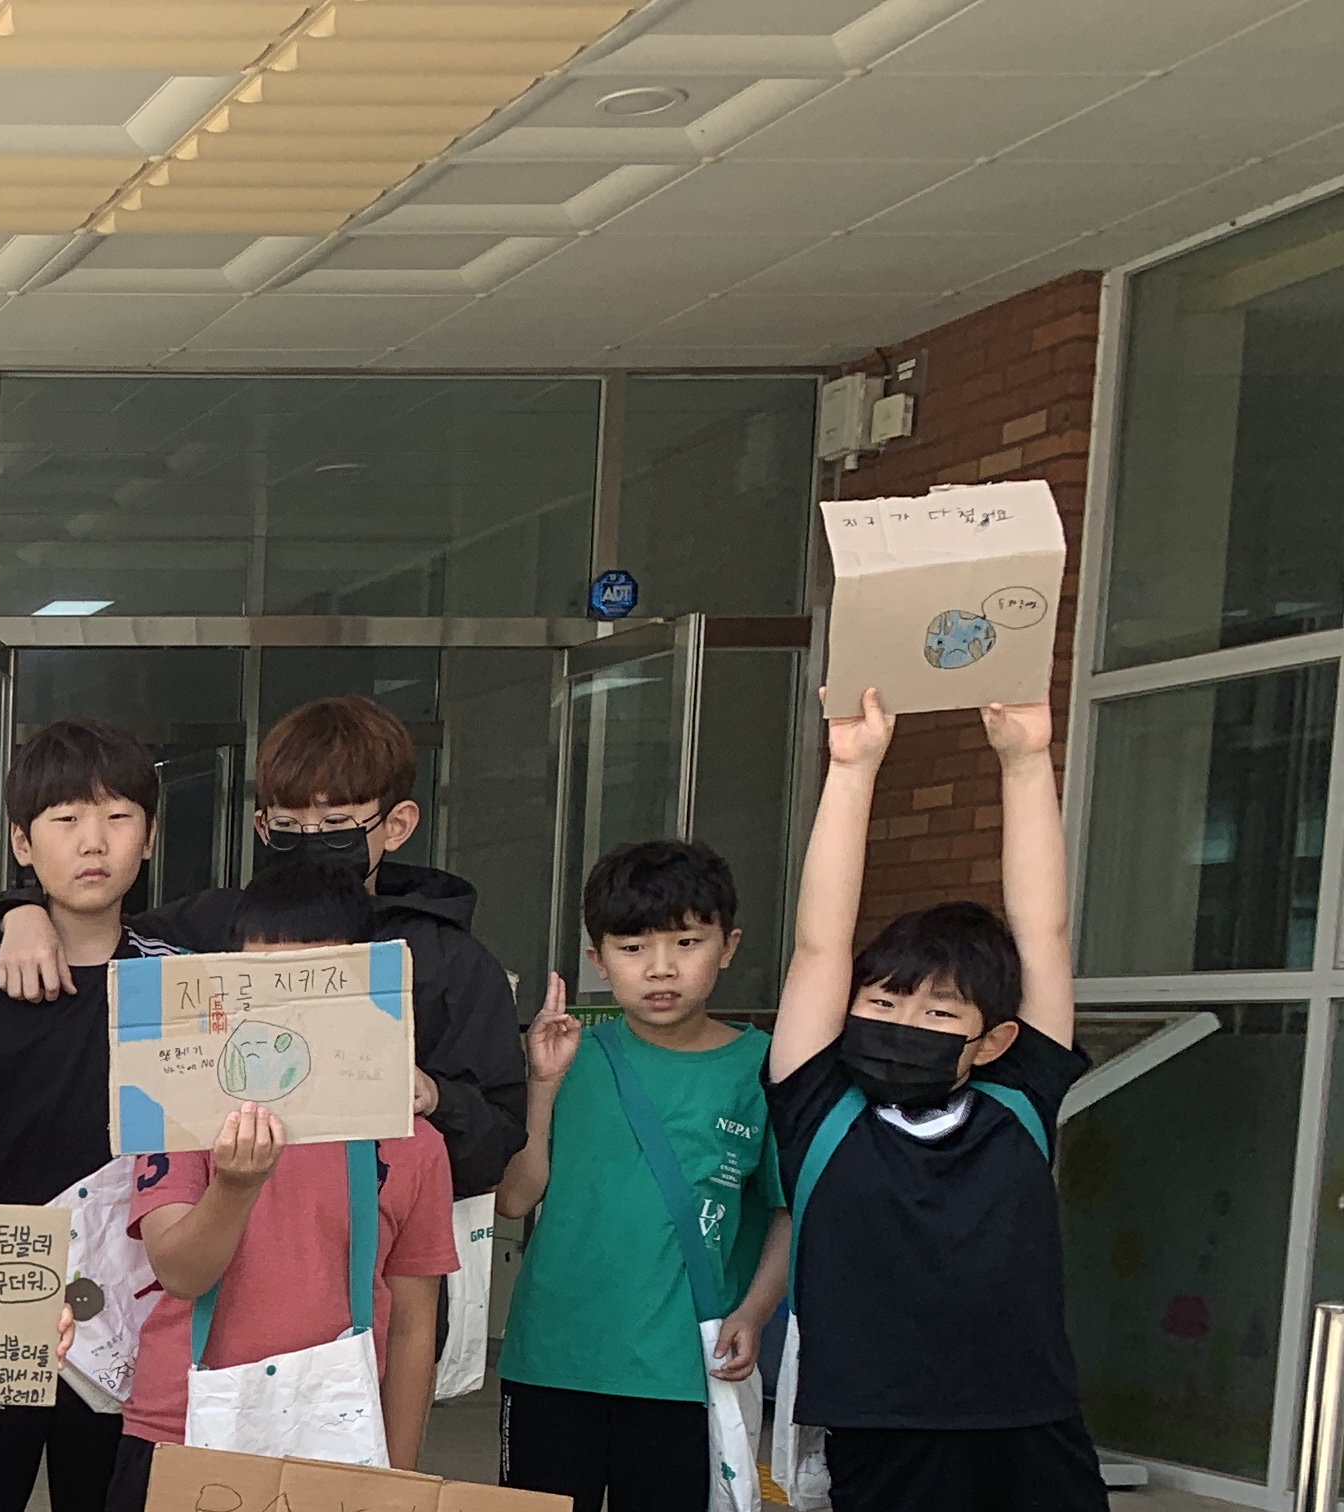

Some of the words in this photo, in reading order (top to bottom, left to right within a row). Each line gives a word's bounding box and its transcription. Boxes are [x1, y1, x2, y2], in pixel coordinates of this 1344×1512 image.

[176, 974, 253, 1013] 지구를
[274, 966, 348, 994] 지키자
[715, 1116, 752, 1140] NEPA
